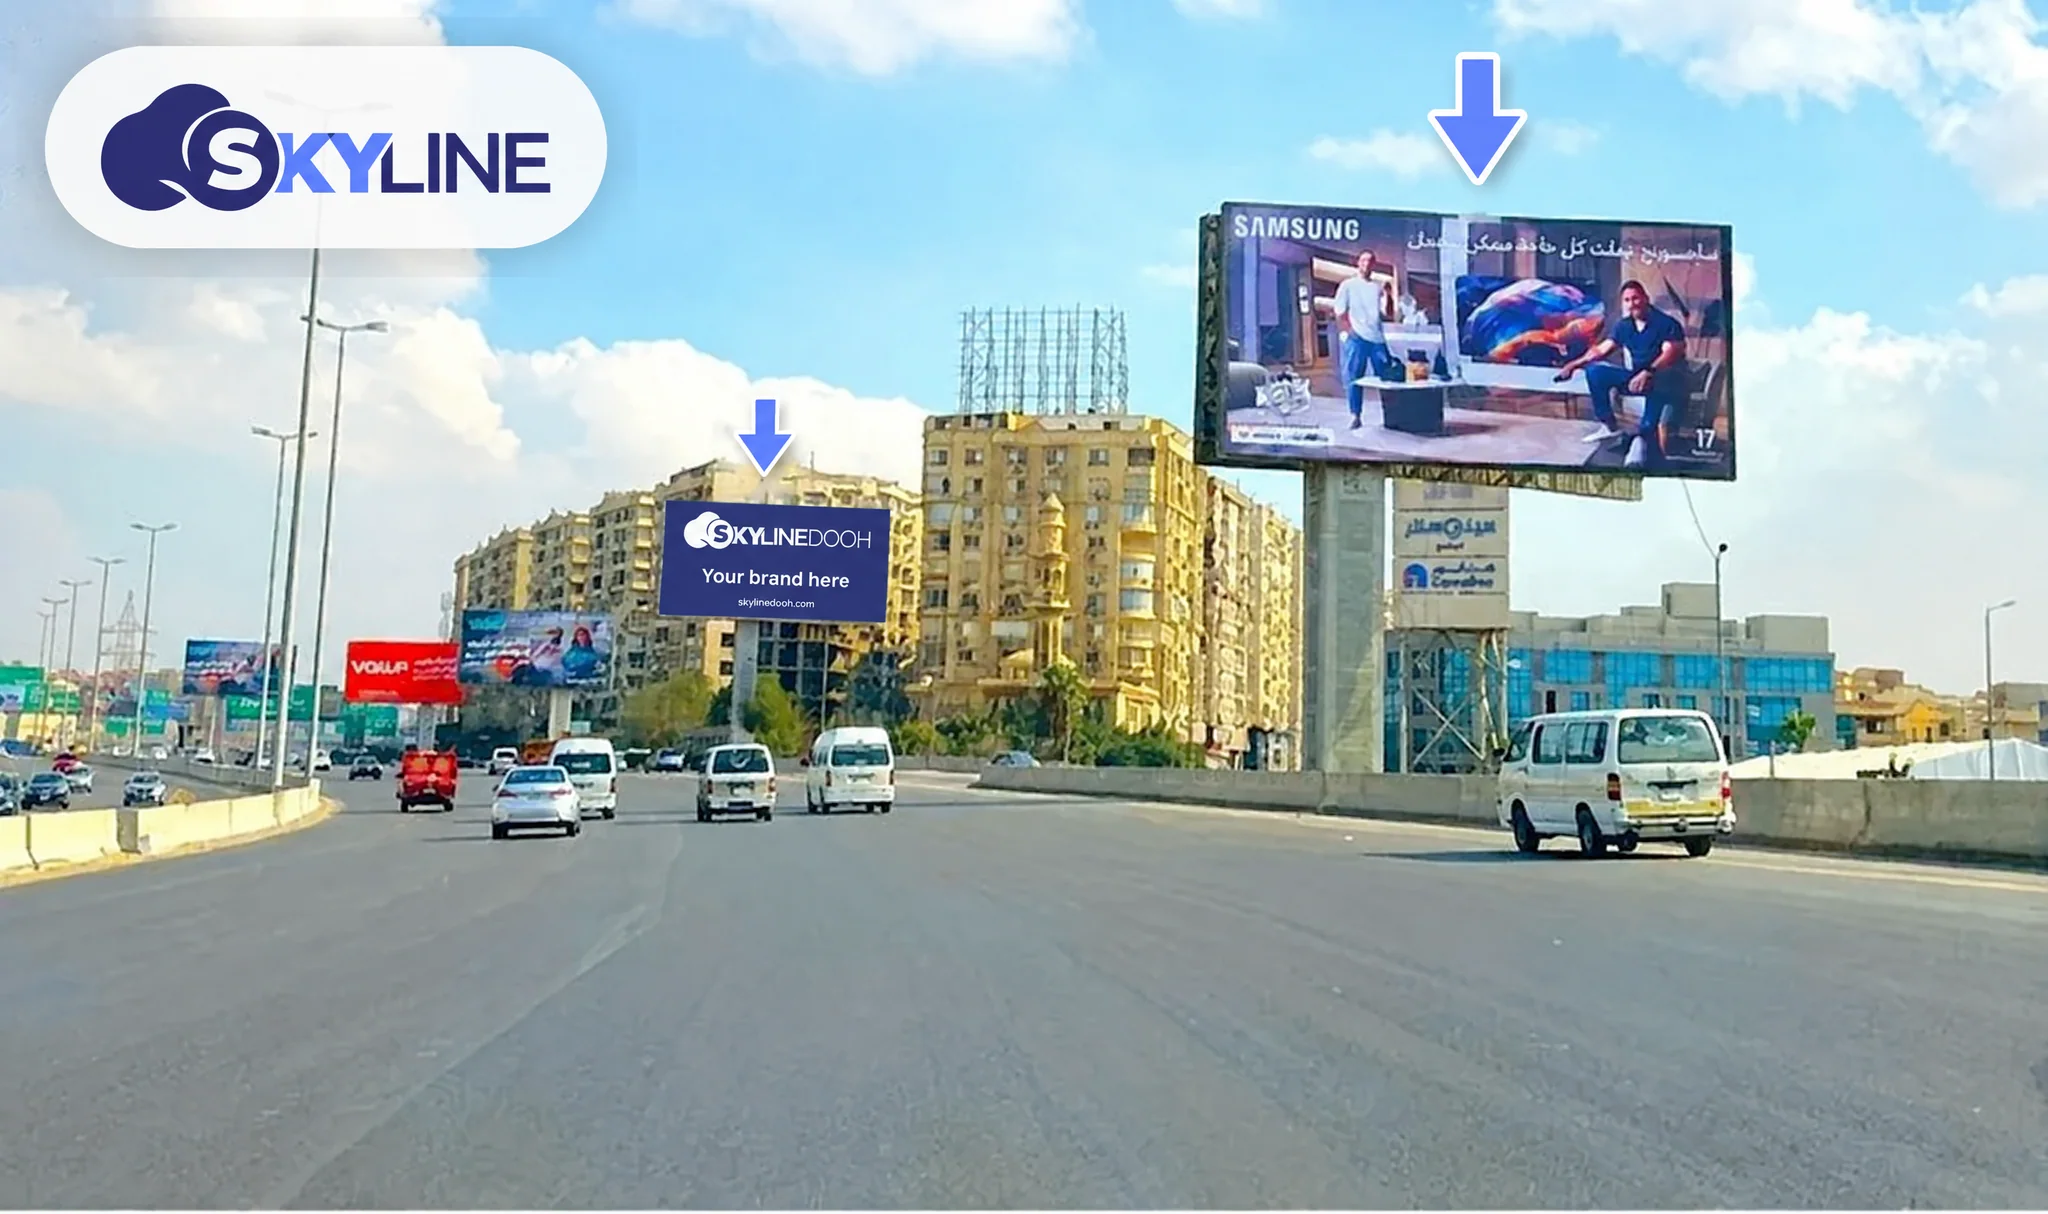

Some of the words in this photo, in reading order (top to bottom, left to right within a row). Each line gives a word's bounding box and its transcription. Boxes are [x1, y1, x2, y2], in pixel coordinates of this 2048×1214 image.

[1234, 213, 1360, 241] SAMSUNG
[1560, 236, 1588, 260] كل
[1695, 428, 1716, 449] 17
[712, 525, 872, 549] SKYLINEDOOH
[702, 568, 745, 585] Your
[749, 569, 803, 587] brand
[808, 571, 850, 588] here
[737, 597, 815, 609] skylinedooh.com
